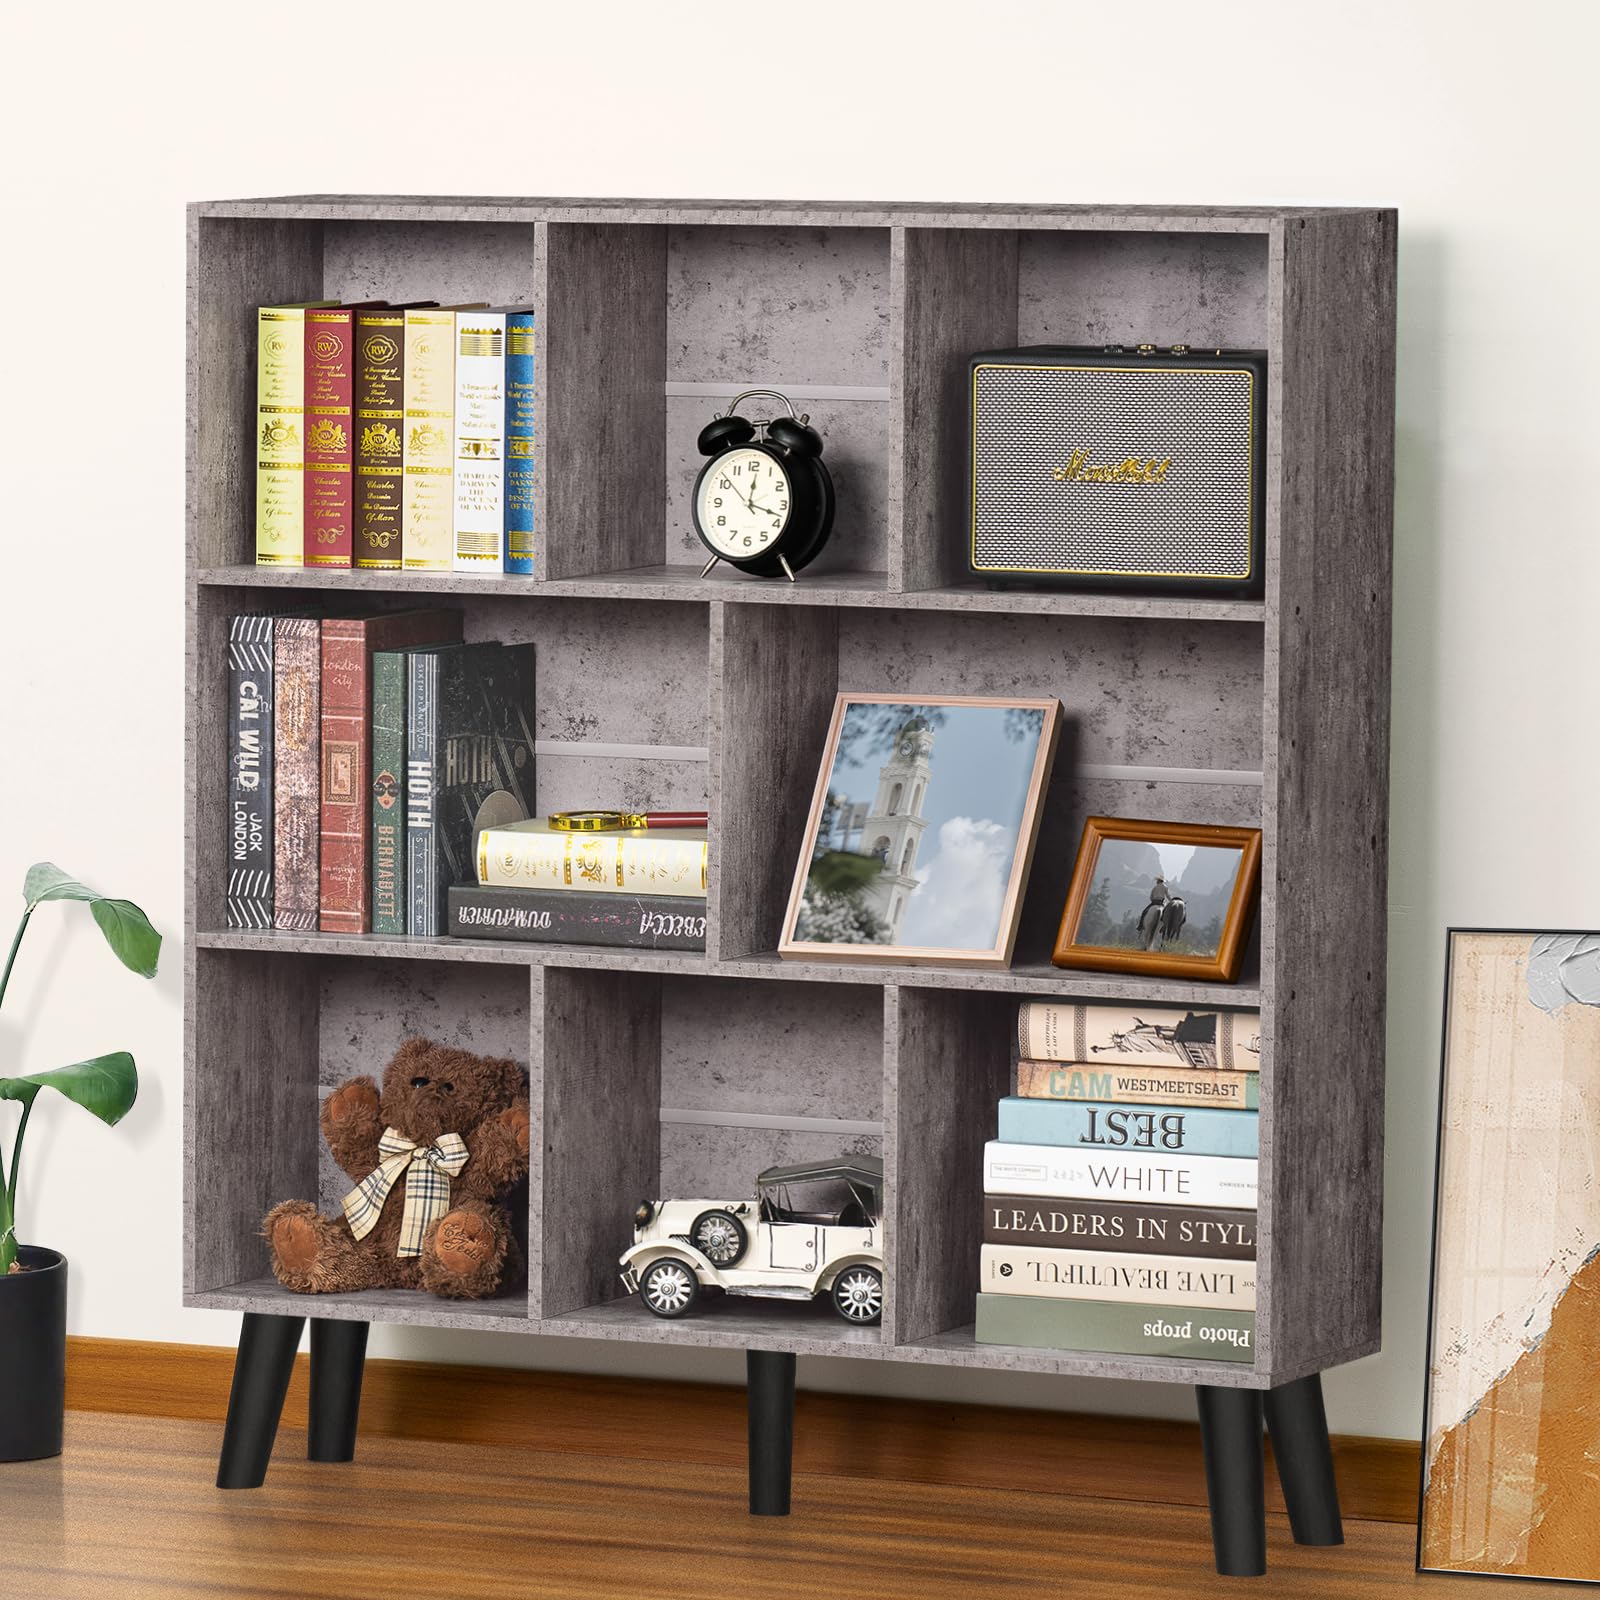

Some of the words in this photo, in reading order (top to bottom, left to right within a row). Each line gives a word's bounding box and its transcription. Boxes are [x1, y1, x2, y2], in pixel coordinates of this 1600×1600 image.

[317, 342, 333, 351] RW
[371, 345, 387, 355] RW
[733, 465, 741, 476] 11
[748, 461, 760, 472] 12
[366, 480, 395, 490] Charles
[719, 479, 731, 490] 10
[775, 481, 784, 492] 2
[713, 497, 723, 508] 9
[780, 500, 788, 511] 3
[374, 513, 395, 521] Man
[717, 516, 726, 526] 8
[772, 518, 781, 529] 4
[729, 530, 738, 541] 7
[743, 536, 752, 547] 6
[760, 531, 768, 542] 5
[240, 681, 259, 720] CAL
[239, 729, 260, 788] WILD
[446, 736, 492, 787] HOTH
[407, 760, 432, 828] HOTH
[234, 801, 247, 861] LONDON
[249, 812, 263, 851] JACK
[458, 906, 552, 928] DUMAURIER
[1049, 1071, 1113, 1098] CAM
[1117, 1077, 1239, 1097] WESTMEETSEAST
[1080, 1108, 1186, 1149] BEST
[1088, 1164, 1191, 1194] WHITE
[993, 1209, 1125, 1237] LEADERS
[1136, 1218, 1167, 1241] IN
[1179, 1221, 1257, 1246] STYL
[1027, 1262, 1170, 1290] BEAUTIFUL
[1177, 1271, 1235, 1294] LIVE
[1143, 1320, 1192, 1339] props
[1199, 1325, 1251, 1347] Photo
